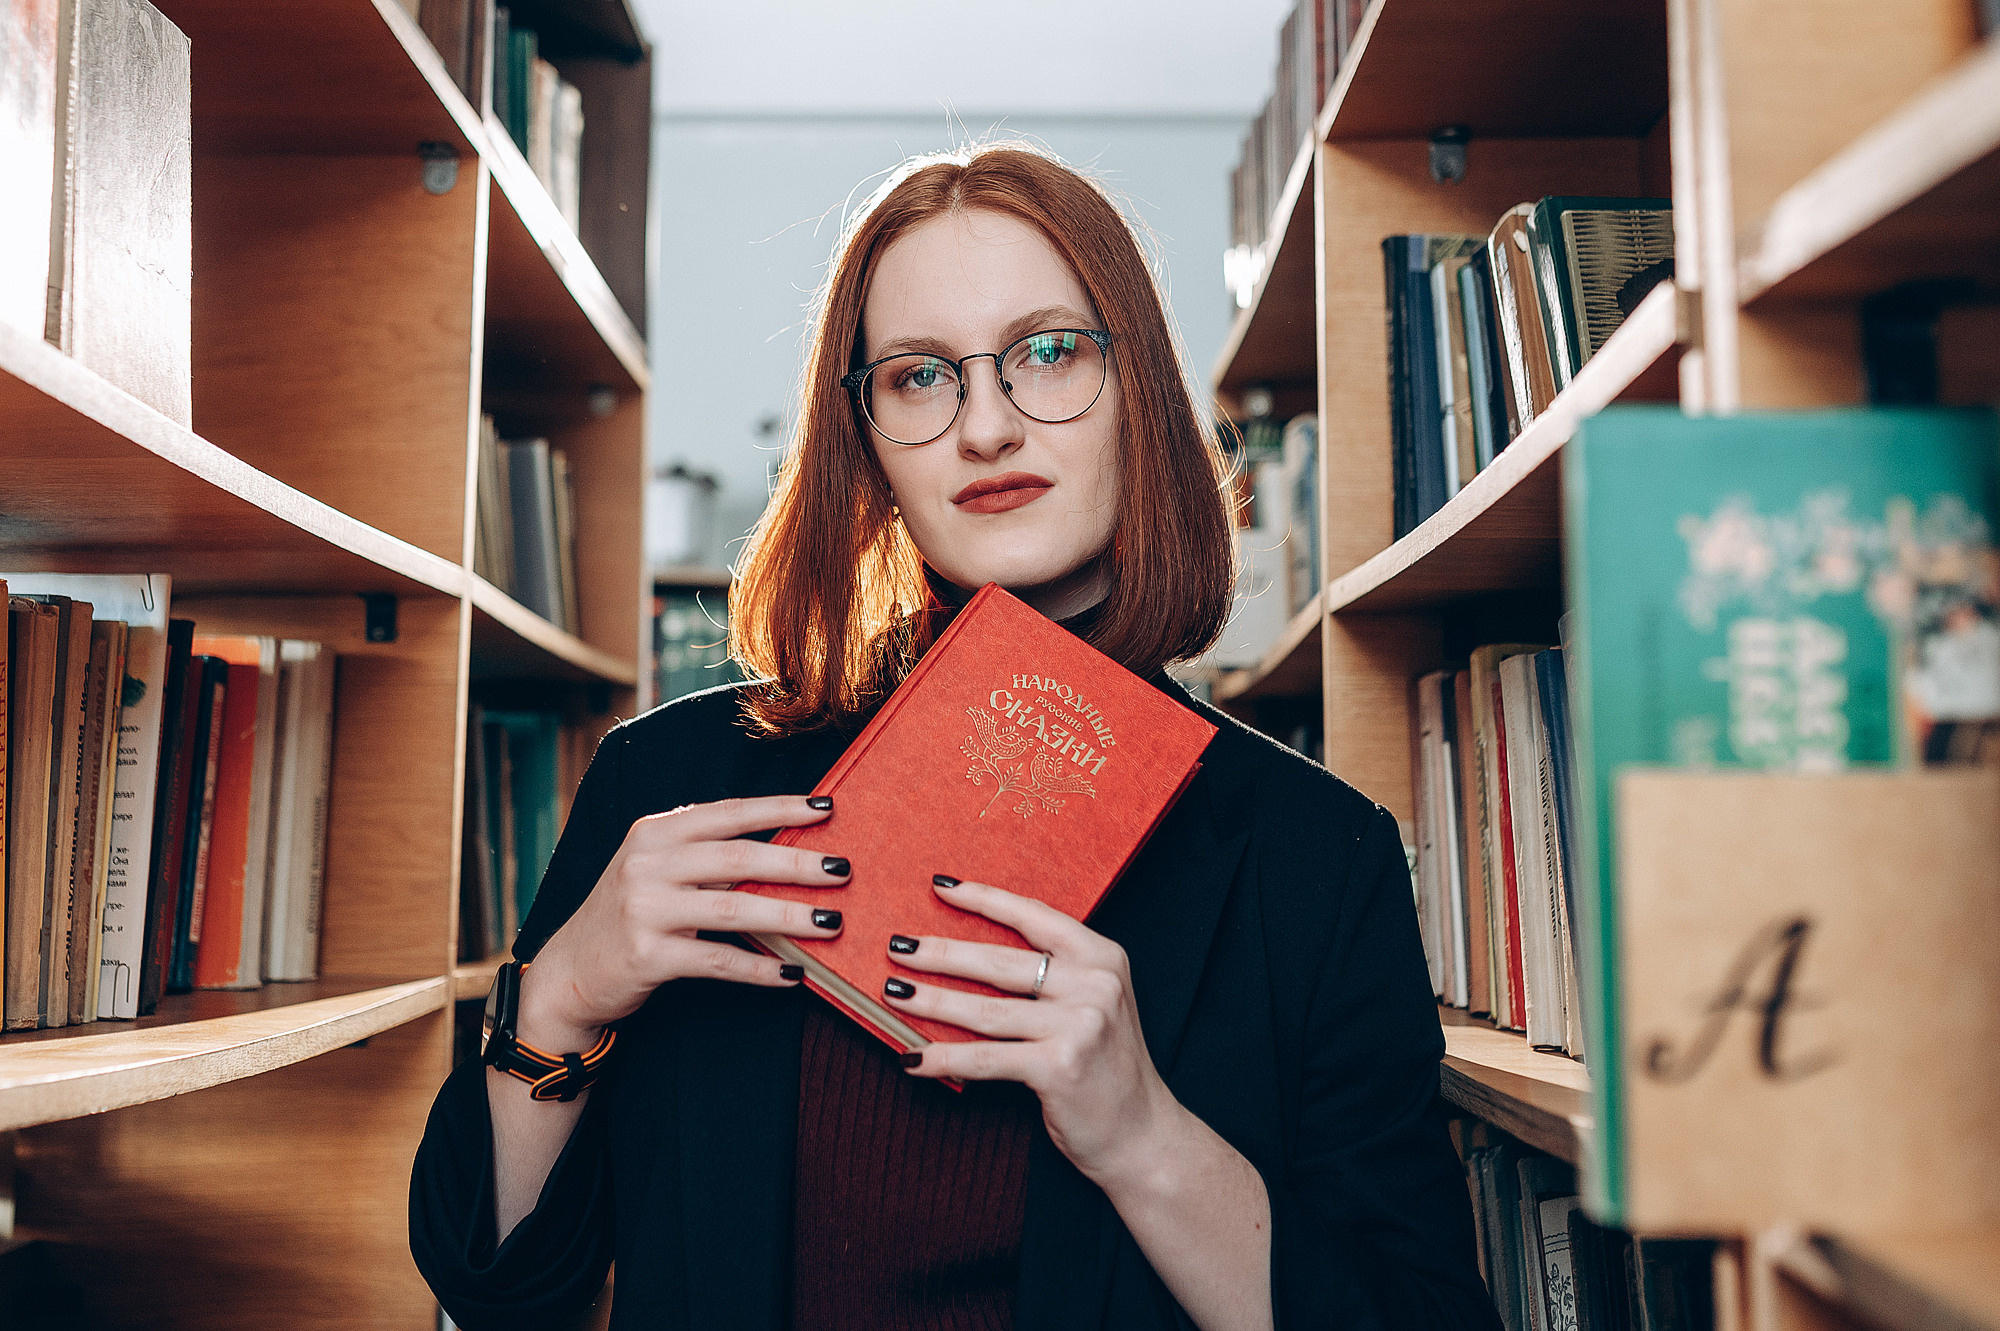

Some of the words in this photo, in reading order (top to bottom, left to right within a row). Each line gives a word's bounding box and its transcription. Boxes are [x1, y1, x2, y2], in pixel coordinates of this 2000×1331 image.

[989, 689, 1107, 776] СКАЗКИ
[1012, 674, 1116, 748] НАРОДНЫЕ
[1035, 696, 1083, 732] РУССКИЕ
[112, 856, 129, 865] Она
